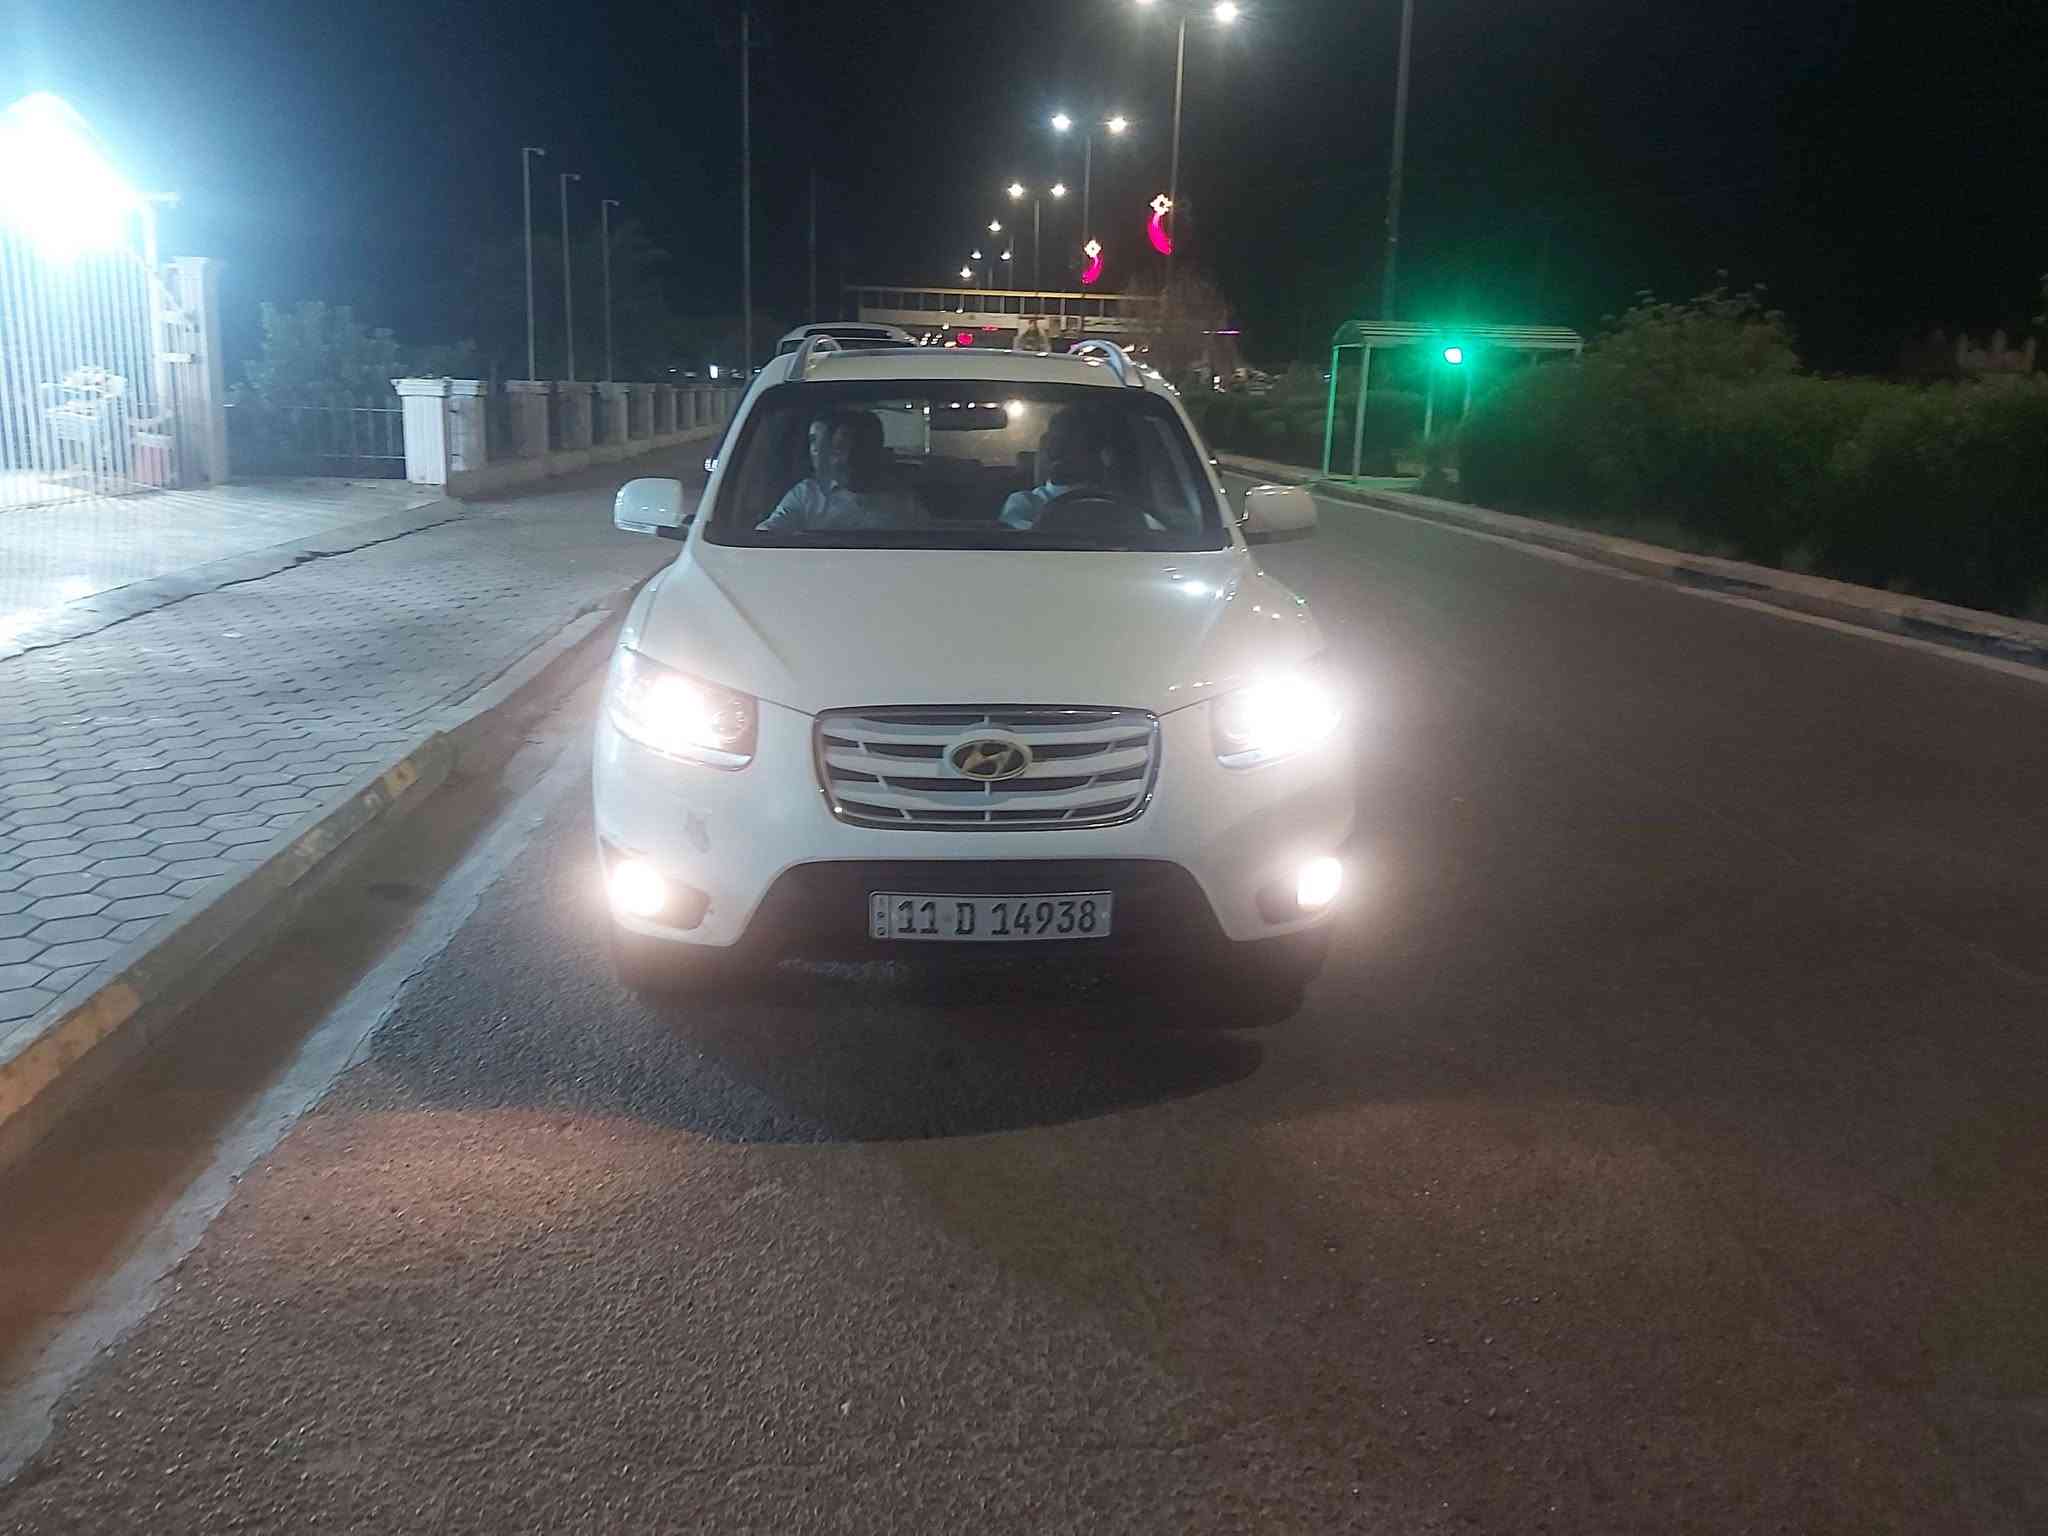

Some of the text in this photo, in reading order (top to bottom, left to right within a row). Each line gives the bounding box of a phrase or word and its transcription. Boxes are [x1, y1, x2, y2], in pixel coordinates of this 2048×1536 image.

[897, 900, 939, 934] 11
[954, 902, 976, 935] D
[991, 899, 1096, 936] 14938
